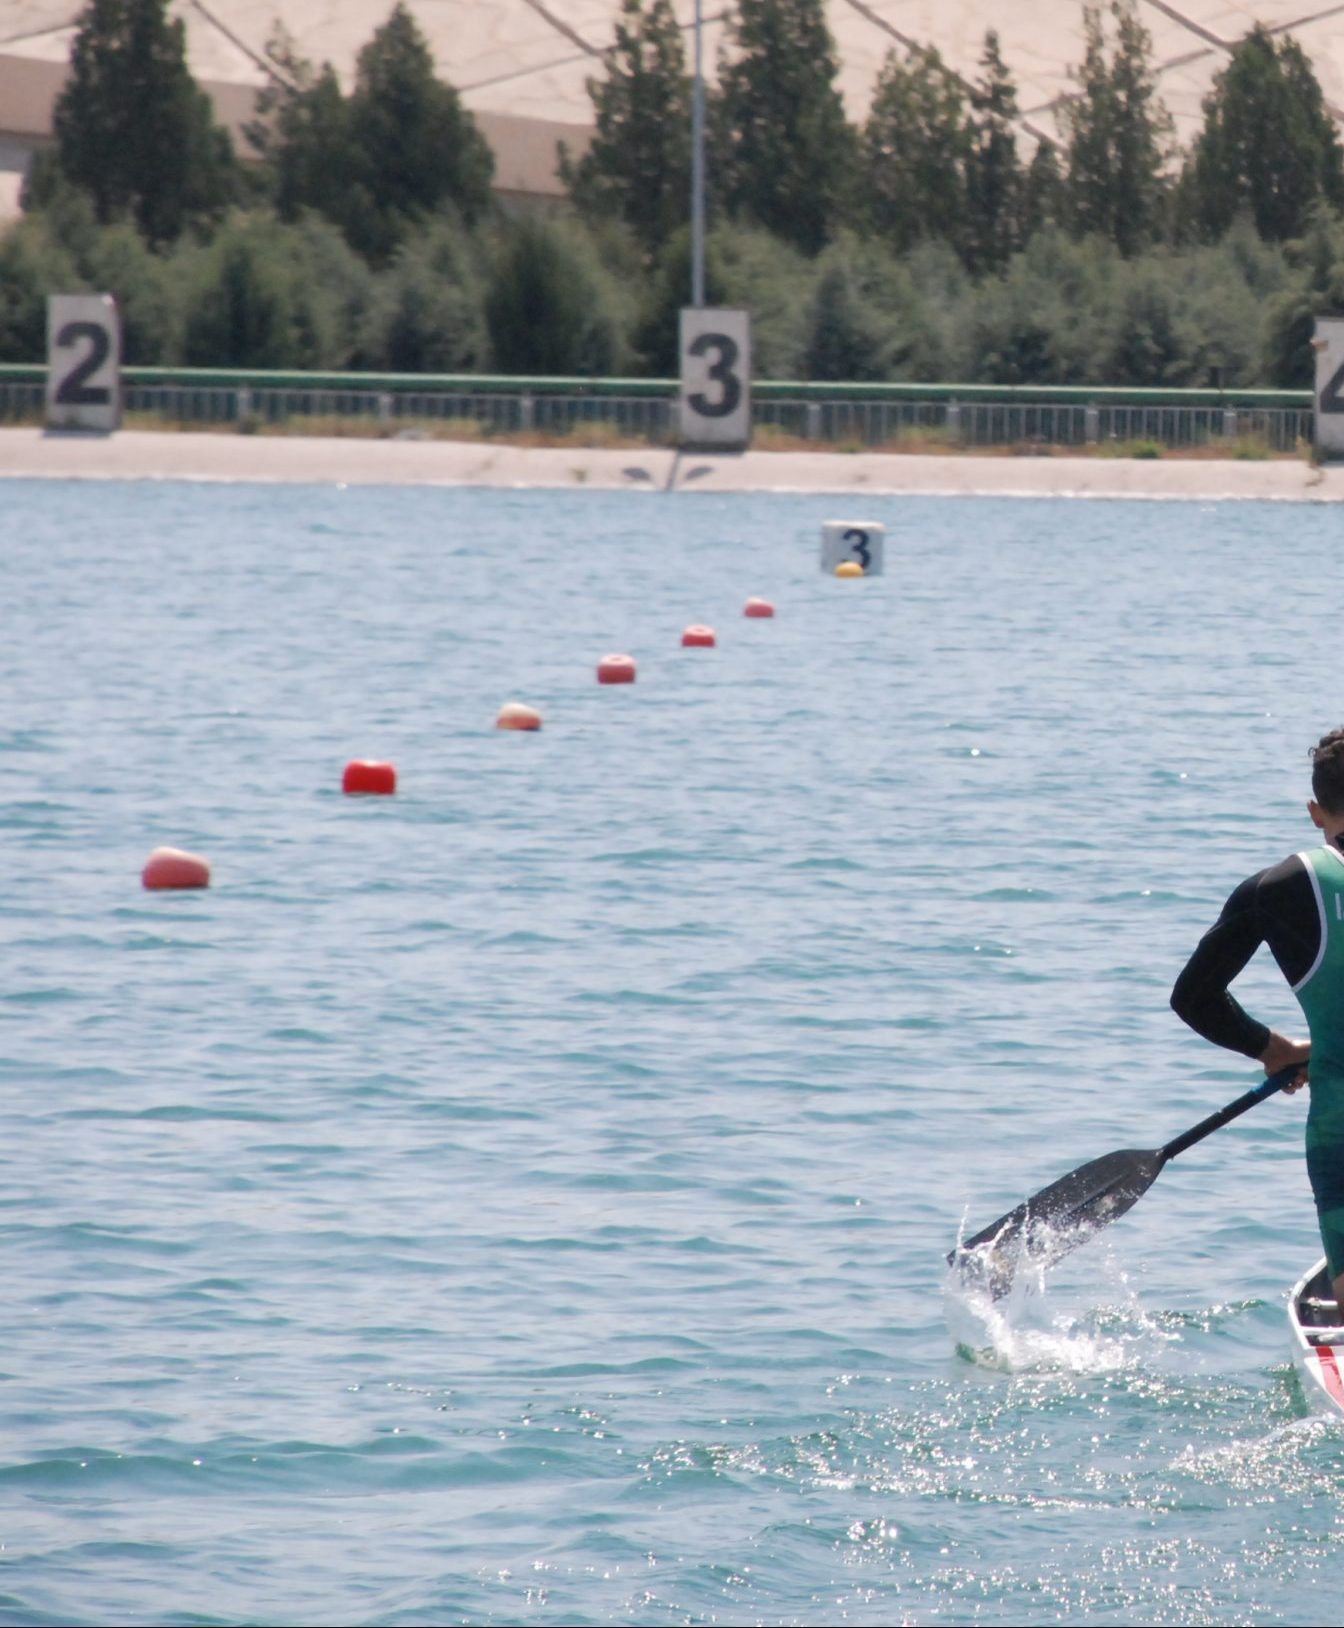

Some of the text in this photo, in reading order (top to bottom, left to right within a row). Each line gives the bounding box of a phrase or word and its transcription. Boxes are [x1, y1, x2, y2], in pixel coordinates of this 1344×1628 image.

[55, 323, 110, 404] 2
[688, 333, 741, 417] 3
[842, 529, 871, 570] 3
